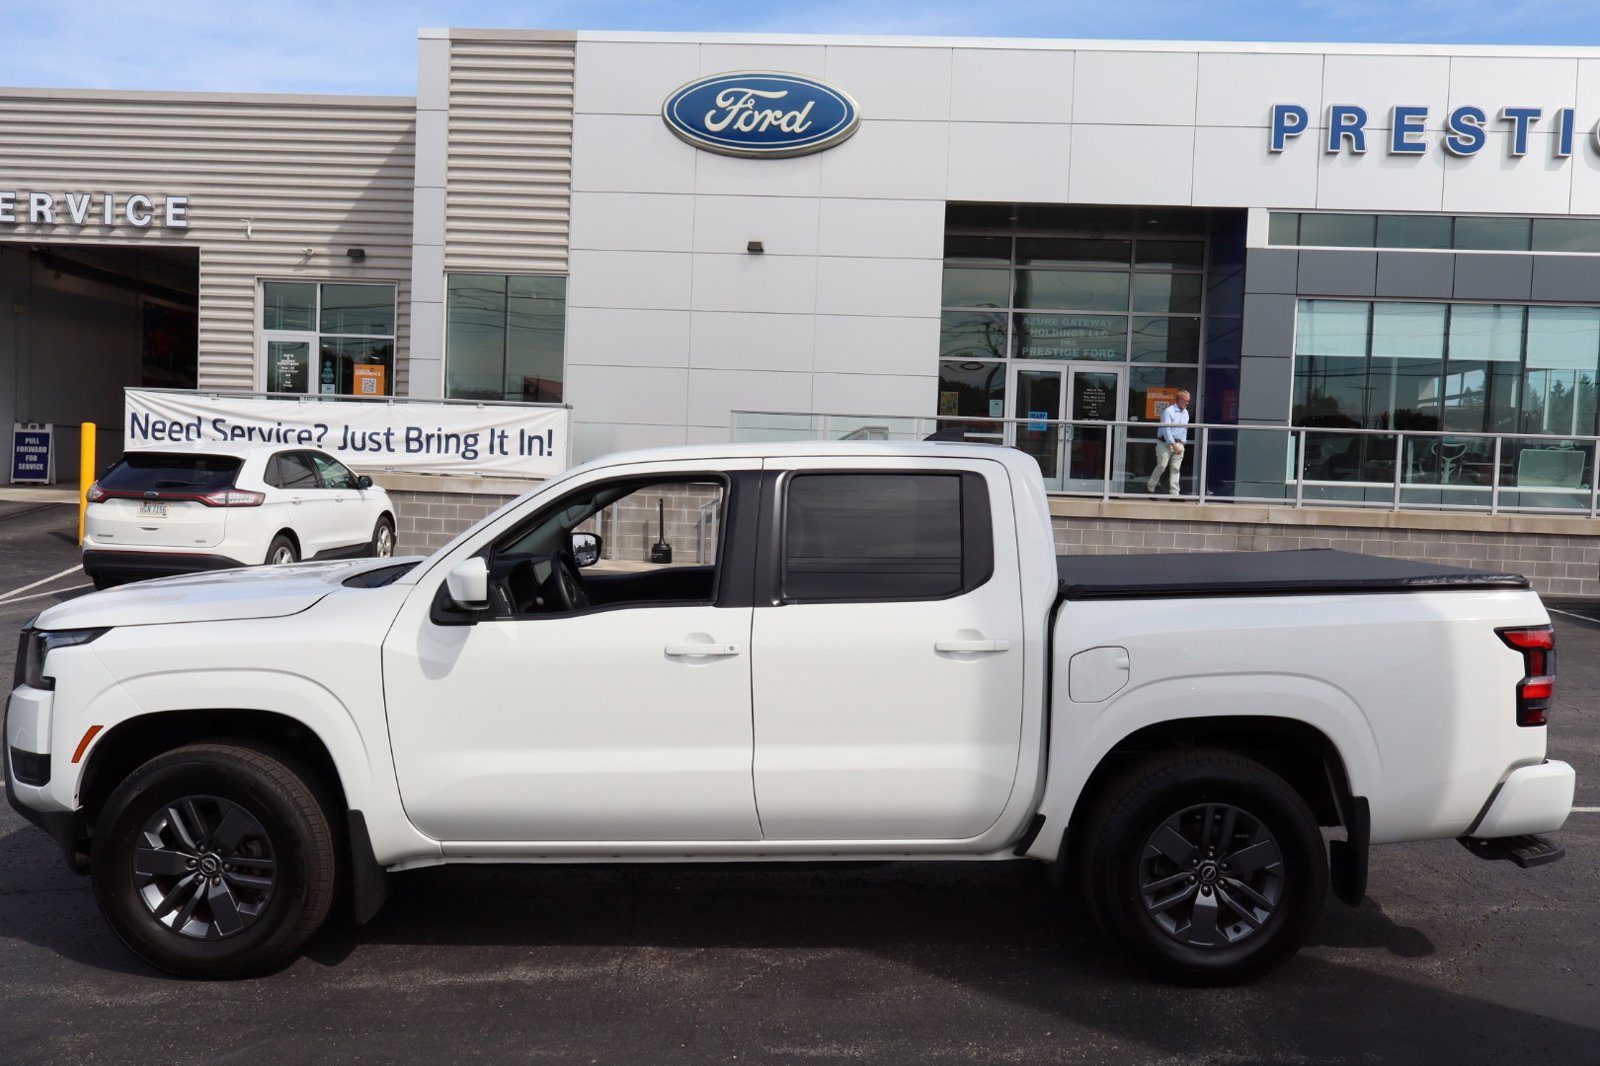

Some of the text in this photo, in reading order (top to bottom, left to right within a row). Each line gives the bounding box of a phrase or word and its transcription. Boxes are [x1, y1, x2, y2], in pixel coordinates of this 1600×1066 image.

[704, 87, 816, 133] Ford
[1270, 103, 1600, 157] PRESTI
[1023, 317, 1114, 327] AZURE GATEWAY
[1030, 328, 1085, 337] HOLDINGS
[1022, 347, 1115, 358] PRESTIGE FORD
[130, 412, 553, 460] Need Service? Just Bring It In!
[16, 445, 48, 453] FORWARD
[25, 454, 38, 462] FOR
